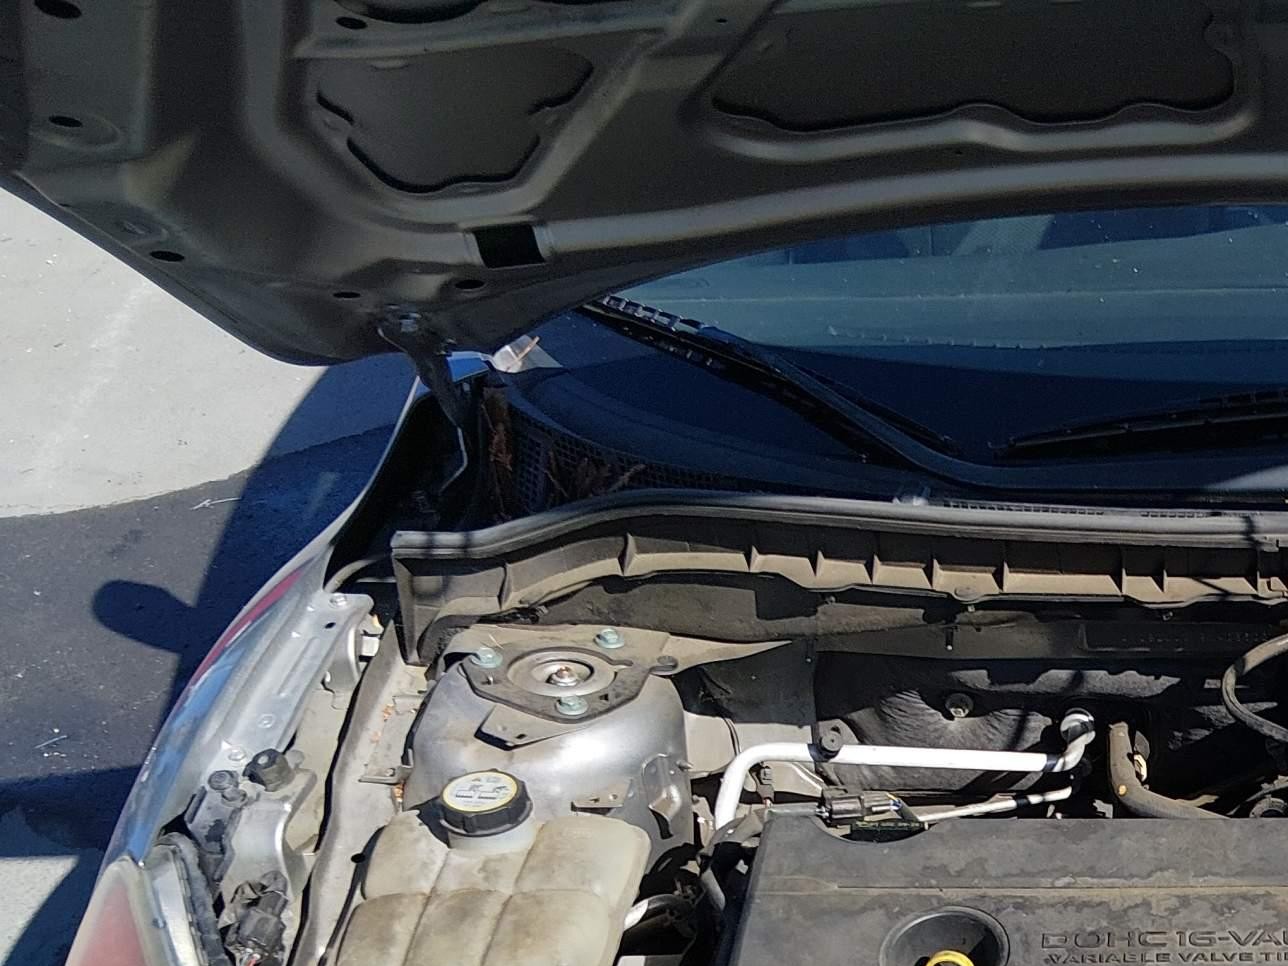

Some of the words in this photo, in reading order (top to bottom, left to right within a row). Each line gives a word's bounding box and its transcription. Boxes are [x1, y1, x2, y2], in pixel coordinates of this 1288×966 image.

[1041, 930, 1169, 949] DOHC
[1047, 952, 1172, 965] VARIABLE
[1177, 951, 1256, 964] VALVE
